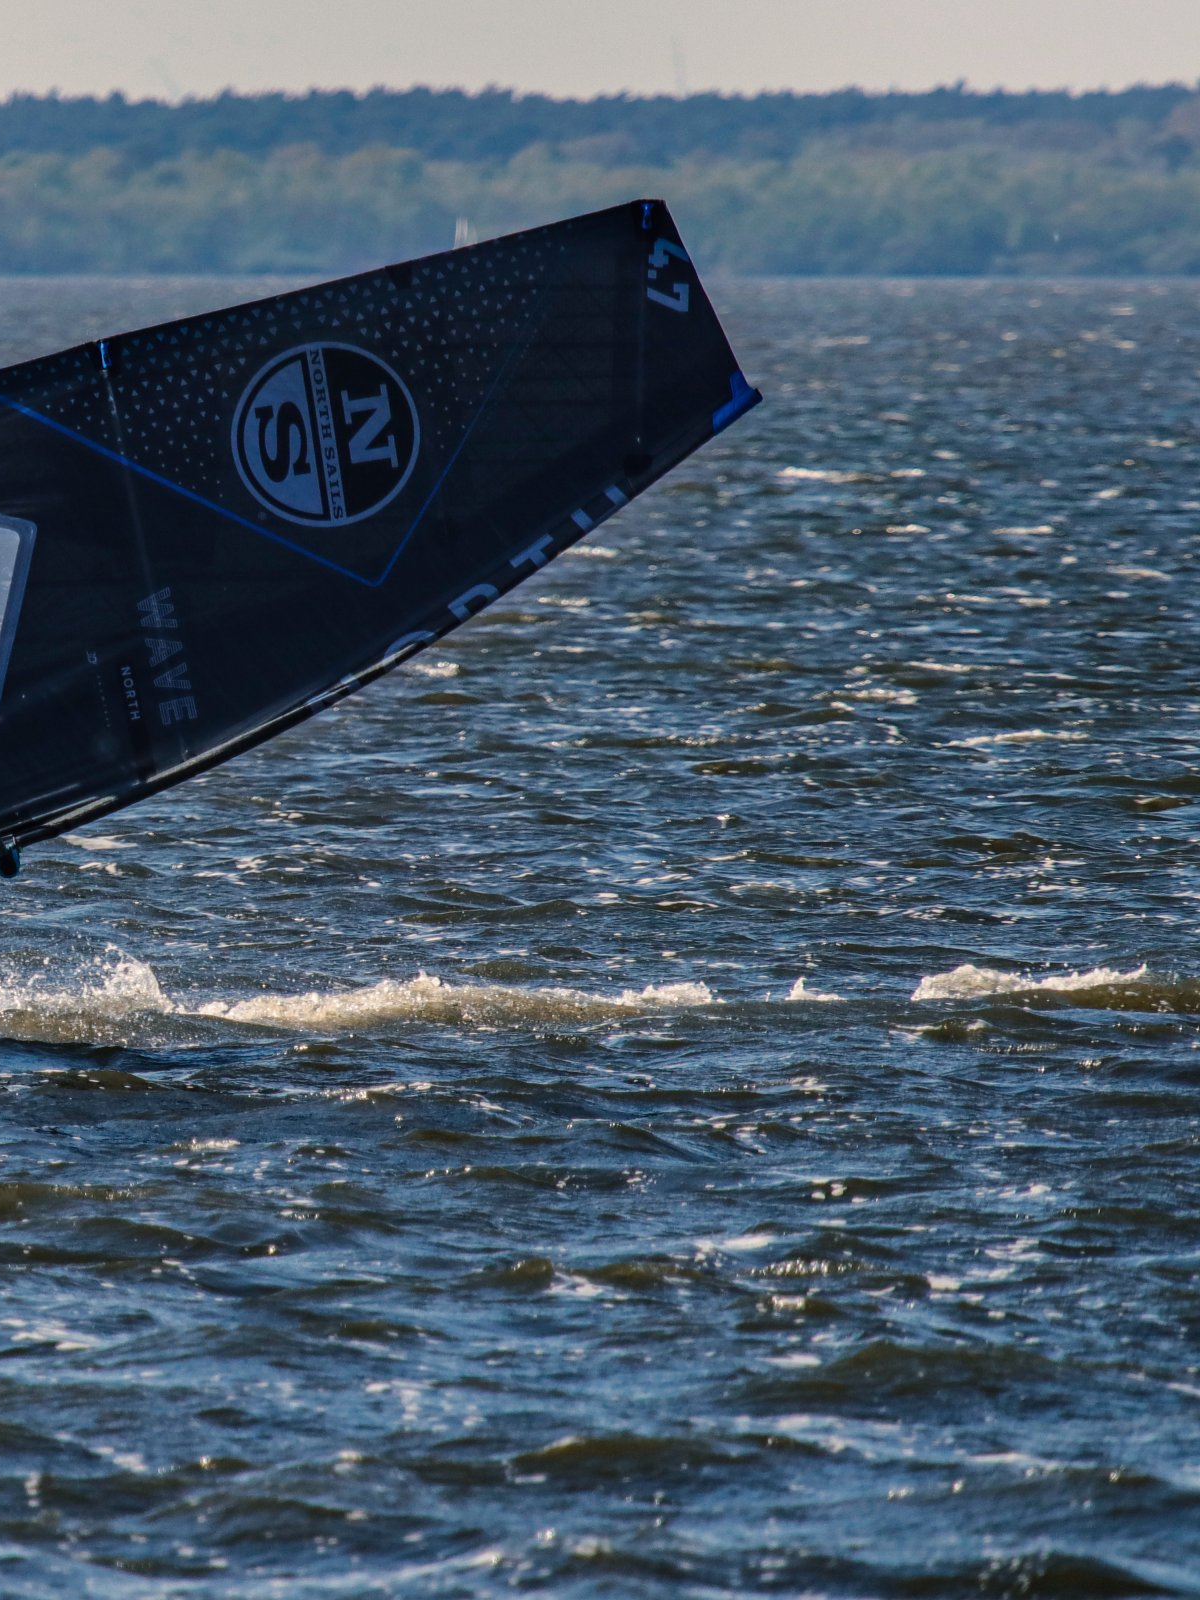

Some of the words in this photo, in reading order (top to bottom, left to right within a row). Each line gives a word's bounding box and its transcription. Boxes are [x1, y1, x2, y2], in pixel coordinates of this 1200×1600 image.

[646, 236, 691, 313] 4.7
[254, 401, 311, 483] S
[308, 349, 334, 438] NORTH
[324, 446, 344, 520] SAILS
[340, 383, 400, 469] N
[120, 664, 142, 721] NORTH
[136, 586, 199, 728] WAVE
